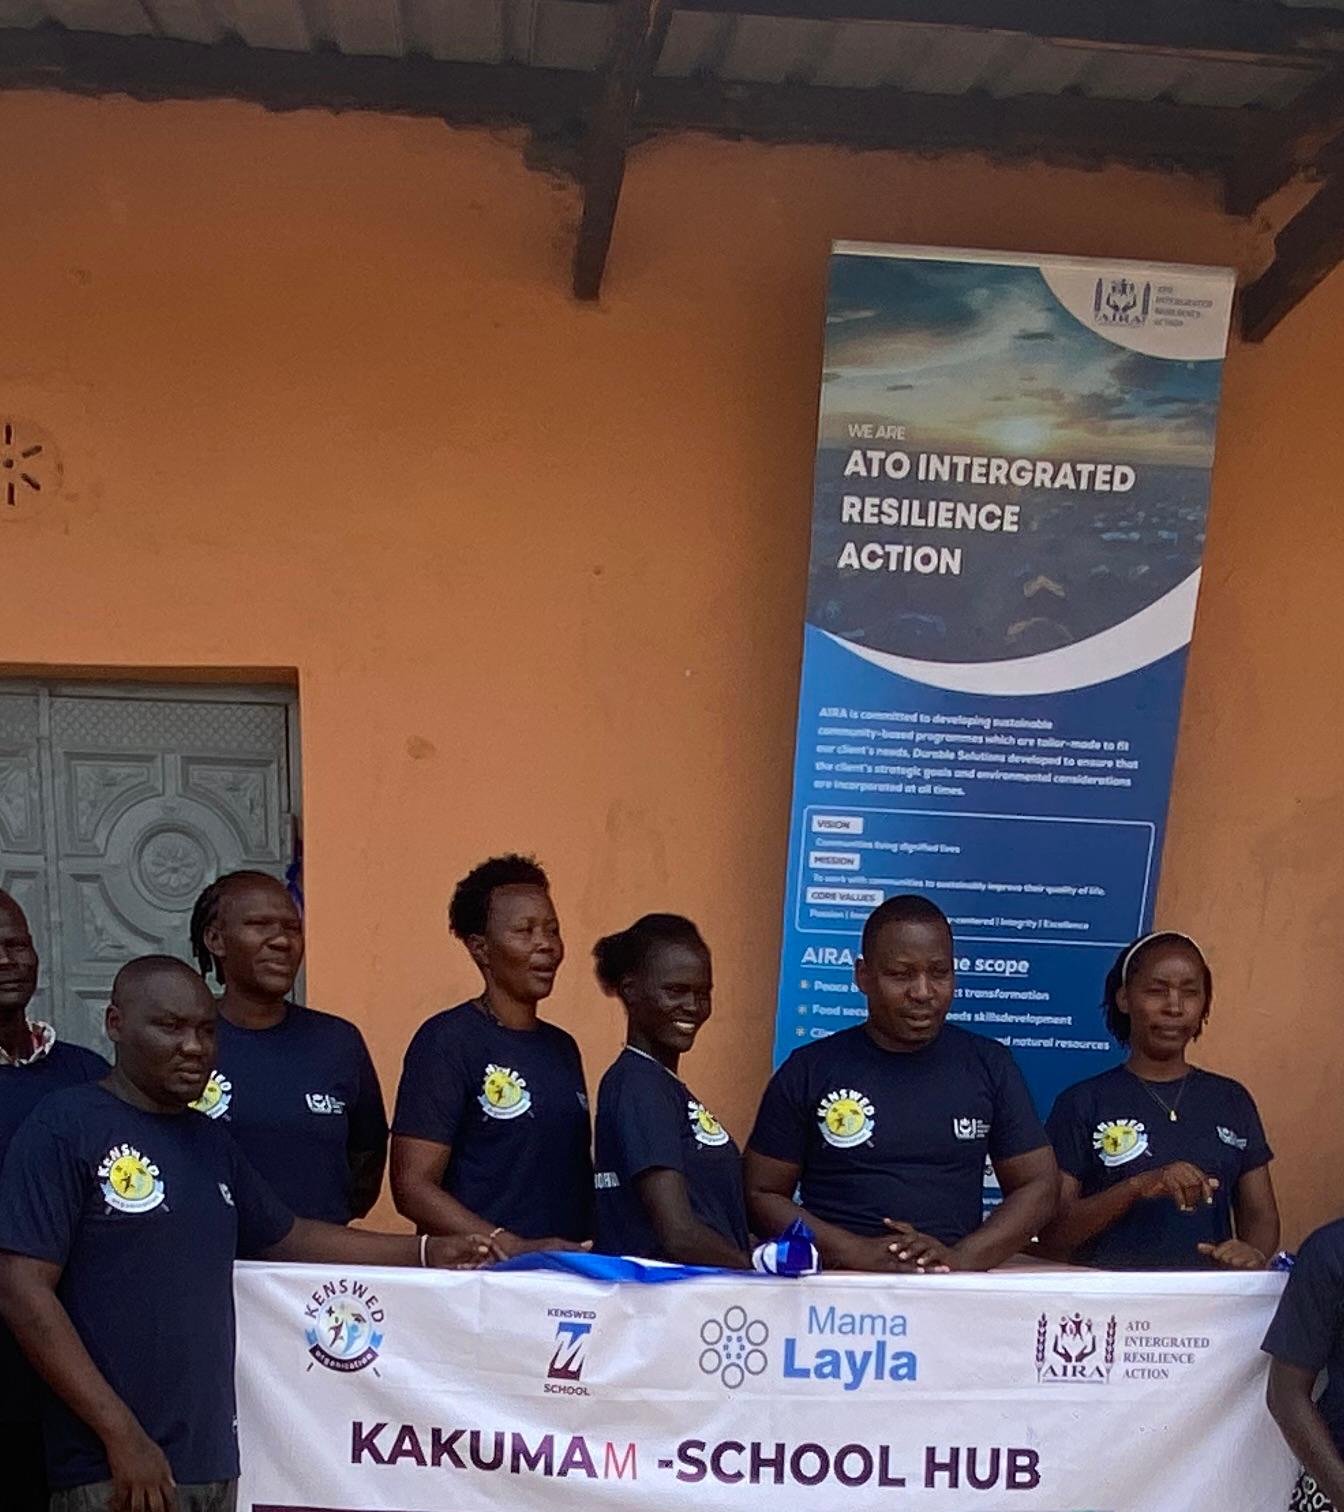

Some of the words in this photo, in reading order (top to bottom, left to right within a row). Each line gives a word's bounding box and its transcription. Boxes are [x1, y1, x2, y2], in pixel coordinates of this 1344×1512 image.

[848, 424, 873, 439] WE
[875, 425, 906, 440] ARE
[844, 449, 910, 479] ATO
[918, 454, 1136, 492] INTERGRATED
[841, 495, 1021, 532] RESILIENCE
[837, 541, 962, 575] ACTION
[860, 710, 918, 723] committed
[932, 714, 991, 730] developing
[985, 733, 1016, 745] which
[1103, 741, 1115, 751] to
[1063, 756, 1076, 767] to
[1116, 757, 1139, 769] that
[874, 764, 921, 778] strategic
[814, 857, 854, 866] MISSION
[801, 946, 853, 965] AIRA
[974, 958, 1030, 976] scope
[964, 988, 1050, 1001] transformation
[812, 1004, 840, 1016] Food
[974, 1011, 1073, 1026] skillsdevelopment
[1012, 1037, 1054, 1048] natural
[1055, 1040, 1110, 1051] resources
[304, 1279, 384, 1323] KENSWED
[547, 1308, 597, 1319] KENSWED
[807, 1305, 907, 1337] Mama
[1126, 1320, 1150, 1331] ATO
[1124, 1336, 1210, 1349] INTERGRATED
[783, 1338, 917, 1391] Layla
[1123, 1352, 1195, 1364] RESILIENCE
[1042, 1364, 1105, 1378] AIRA
[1123, 1368, 1169, 1379] ACTION
[544, 1384, 590, 1396] SCHOOL
[923, 1446, 1041, 1490] HUB
